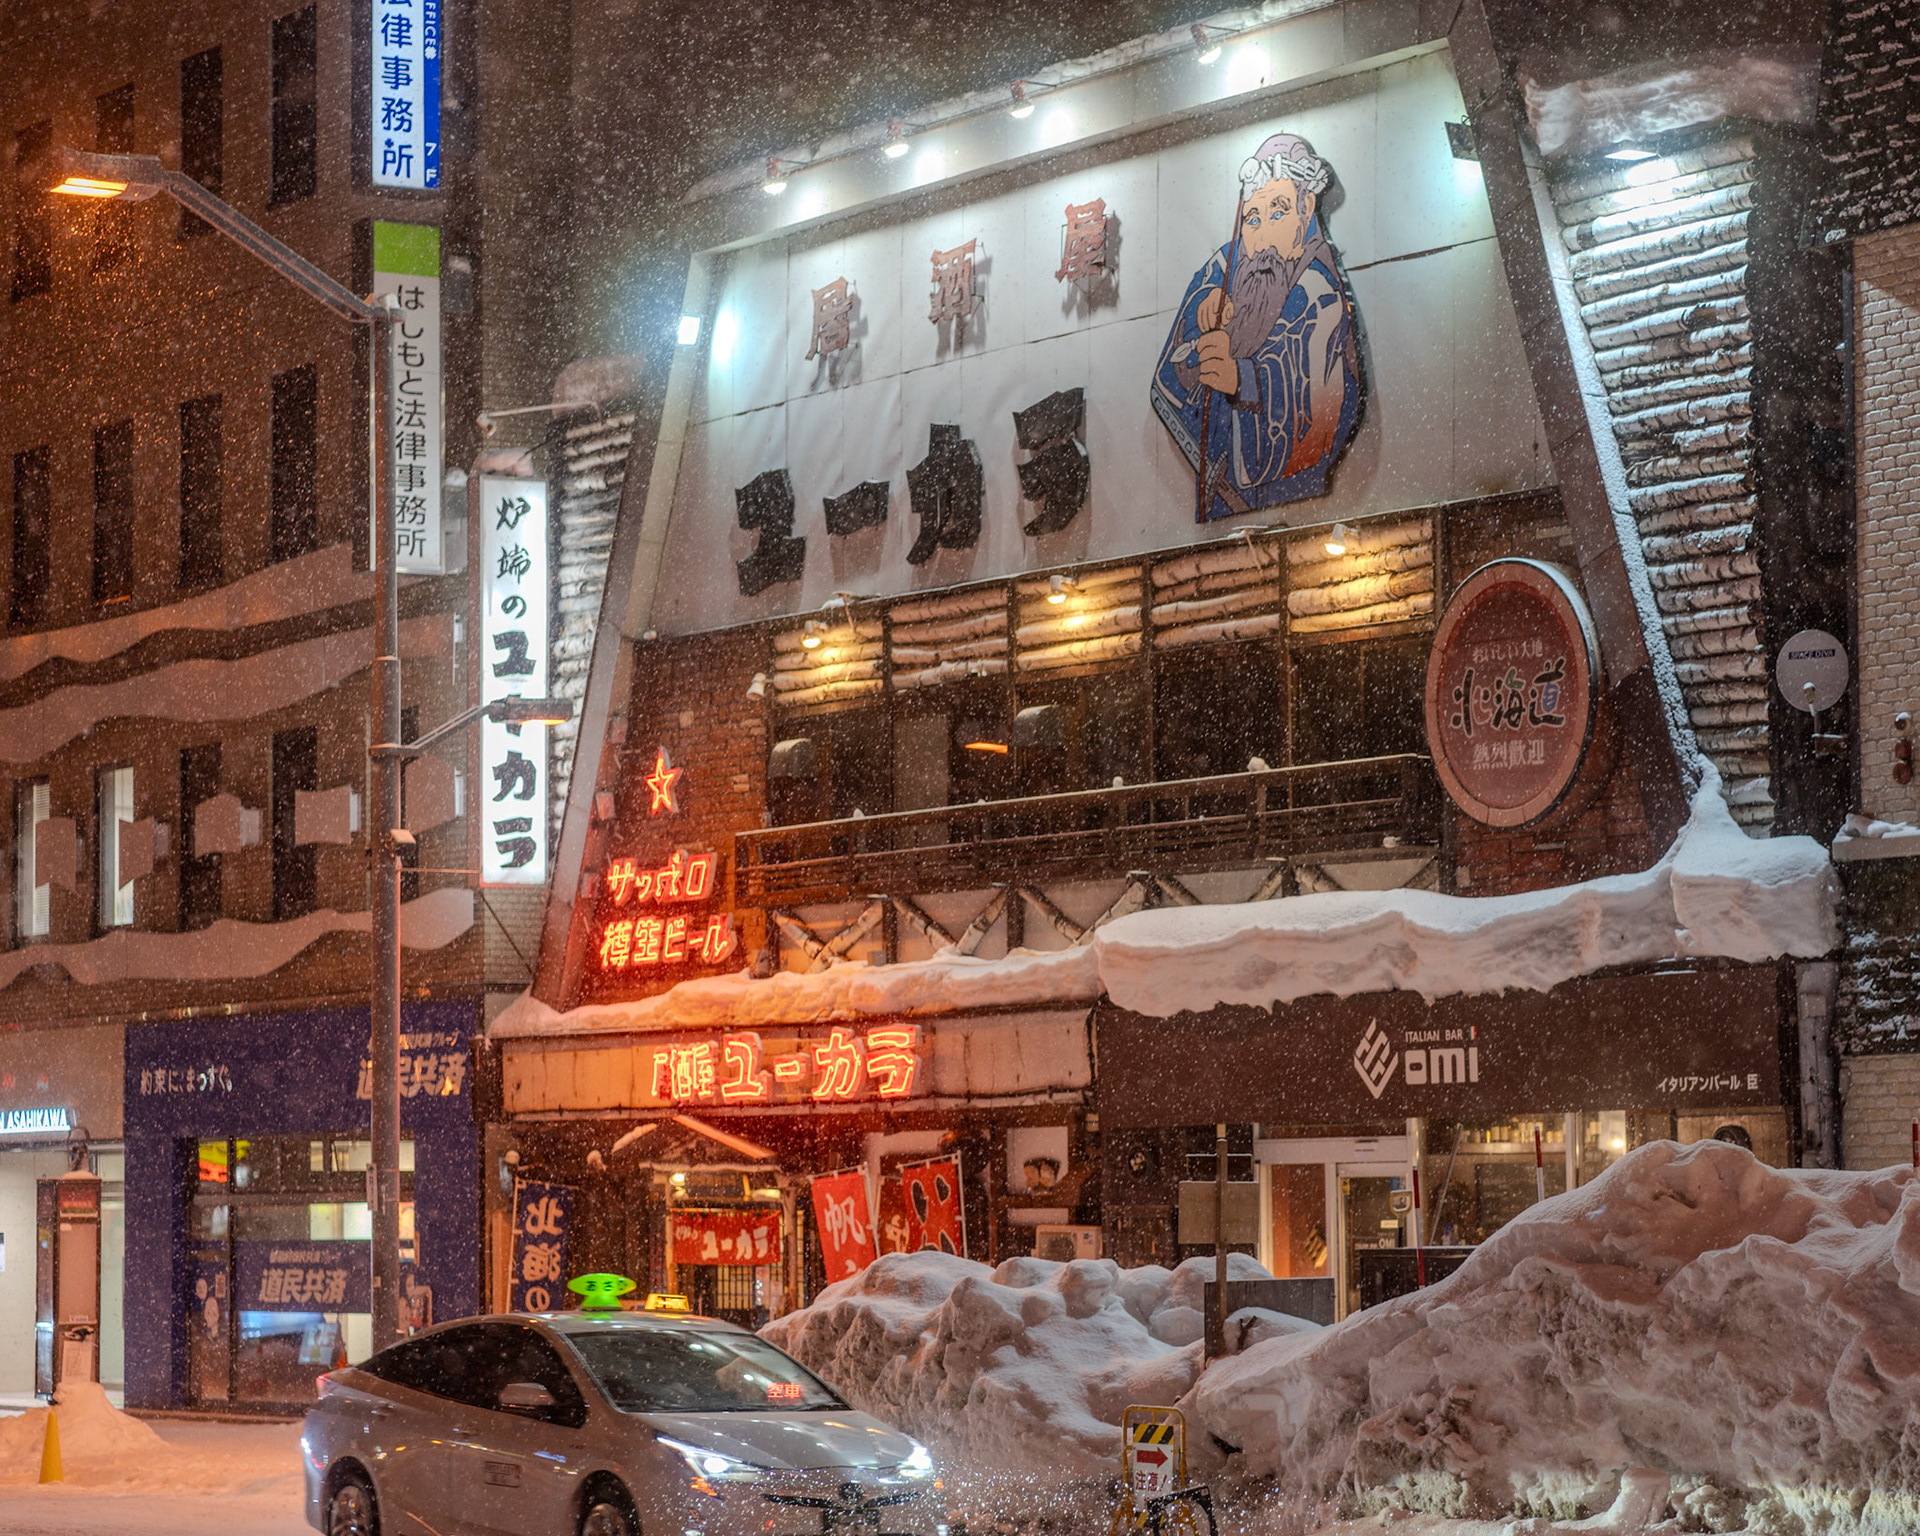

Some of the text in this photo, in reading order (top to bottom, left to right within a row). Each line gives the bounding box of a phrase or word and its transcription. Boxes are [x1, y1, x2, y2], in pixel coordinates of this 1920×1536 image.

[380, 0, 414, 178] 律事務所
[395, 284, 427, 558] はしもと法律事務所
[734, 387, 1090, 596] ユーカラ
[1451, 656, 1567, 738] 北海道
[608, 853, 712, 904] サッポロ
[1405, 1028, 1464, 1043] ITALIAN BAR
[719, 1025, 918, 1103] ユーカラ
[1658, 1075, 1742, 1093] イタリアンバール
[6, 1107, 68, 1129] ASAHIKAWA
[258, 1268, 348, 1304] 道民共済
[767, 1382, 801, 1399] 空車
